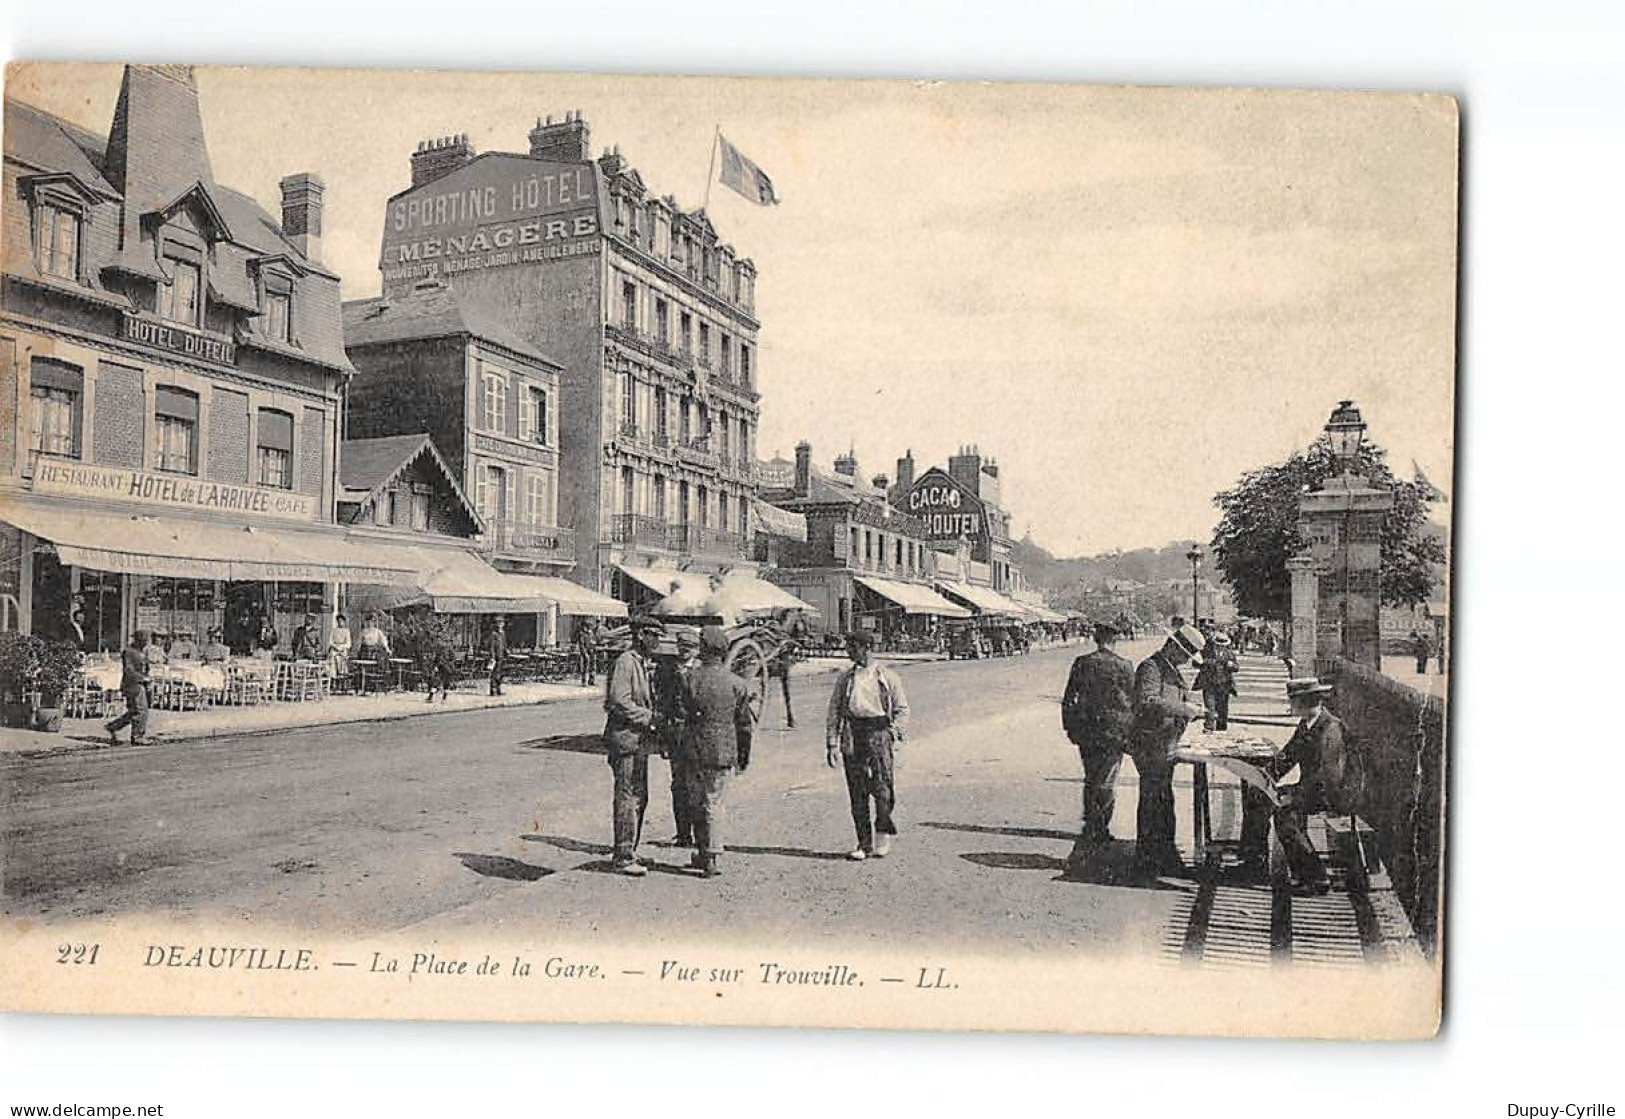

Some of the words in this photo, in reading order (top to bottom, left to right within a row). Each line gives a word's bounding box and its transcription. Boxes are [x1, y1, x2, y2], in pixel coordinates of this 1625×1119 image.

[394, 186, 496, 231] SPORTING
[512, 168, 591, 211] HÔTEL
[129, 318, 176, 348] HOTEL
[185, 334, 235, 363] DUTEIL
[181, 483, 195, 503] de
[910, 487, 960, 510] CACAO
